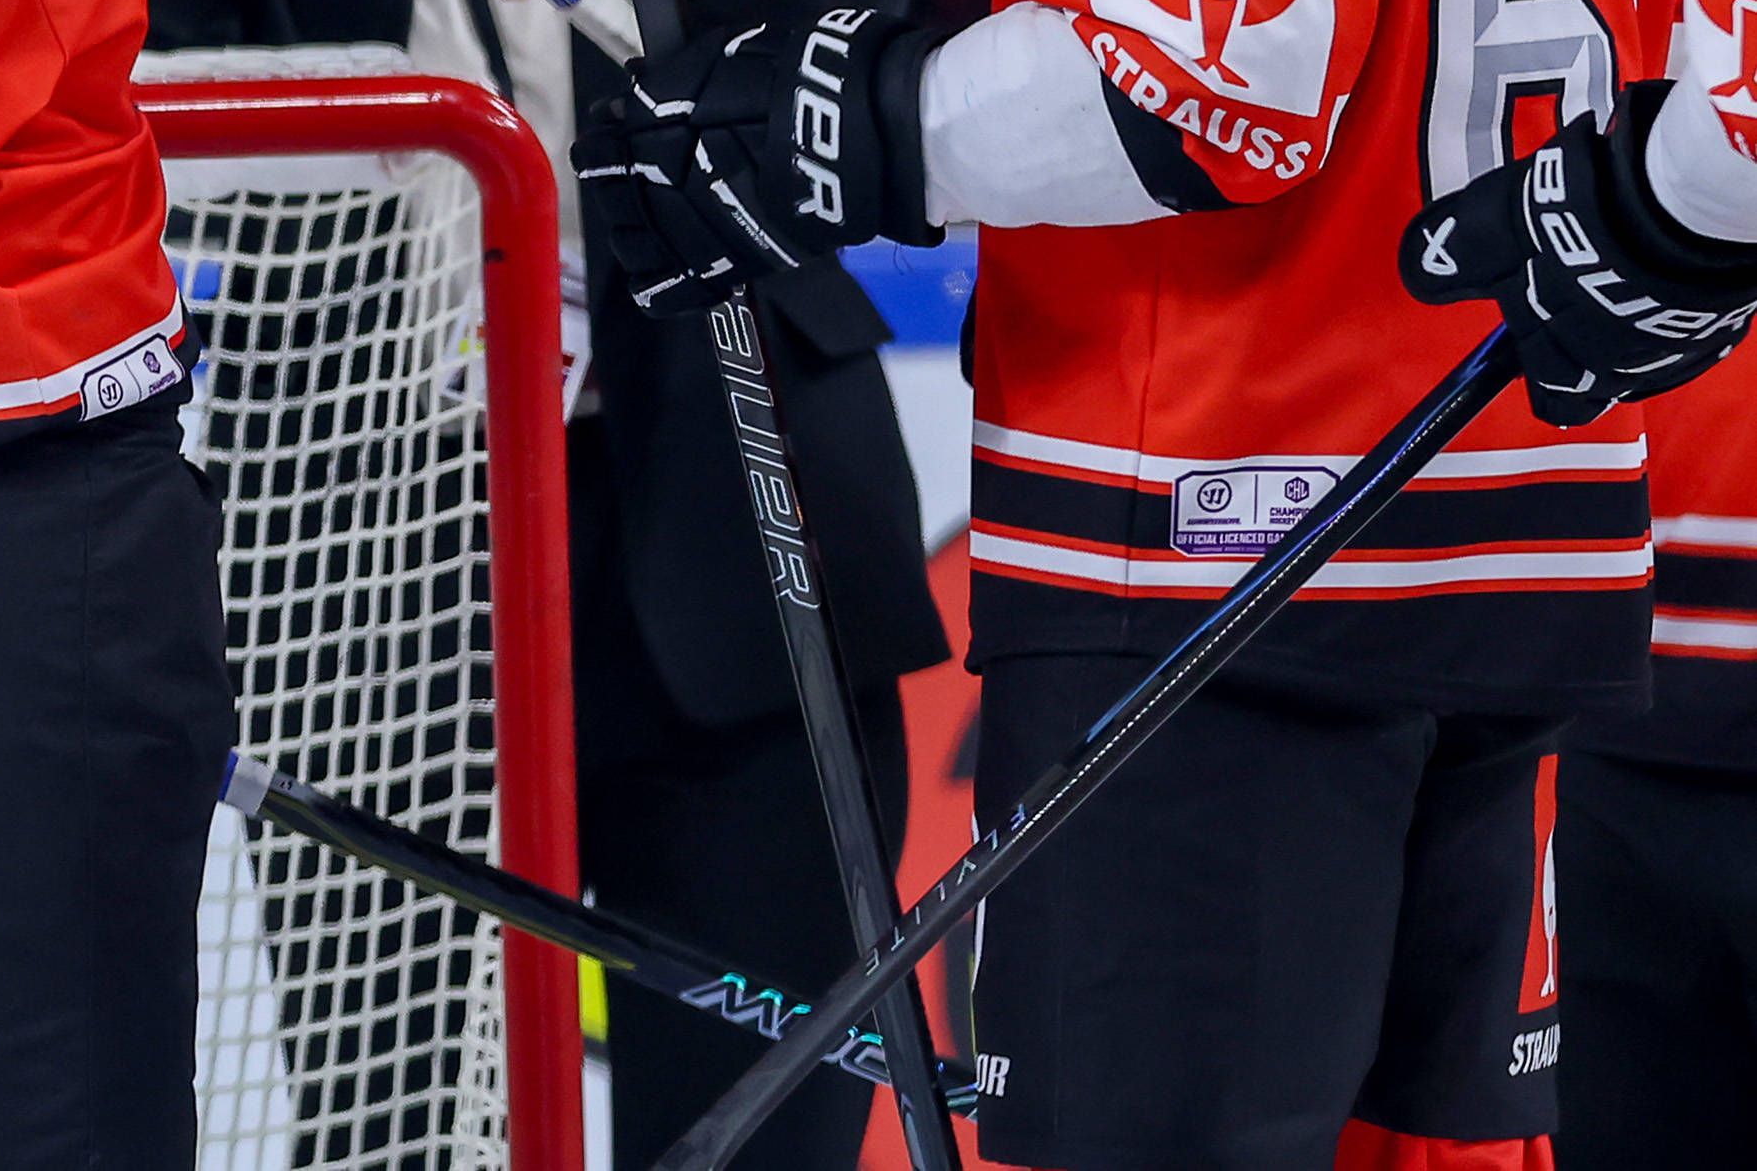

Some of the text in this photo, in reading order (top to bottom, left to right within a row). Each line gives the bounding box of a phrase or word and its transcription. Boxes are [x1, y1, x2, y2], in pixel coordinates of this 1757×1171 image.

[795, 8, 877, 225] AUER
[1091, 32, 1312, 179] STRAUSS
[1532, 145, 1757, 340] BAUER
[710, 290, 820, 610] AUER
[1285, 478, 1308, 503] CHL
[1176, 533, 1217, 544] OFFICIAL
[1267, 533, 1284, 544] GA
[1508, 1022, 1561, 1076] STRAU
